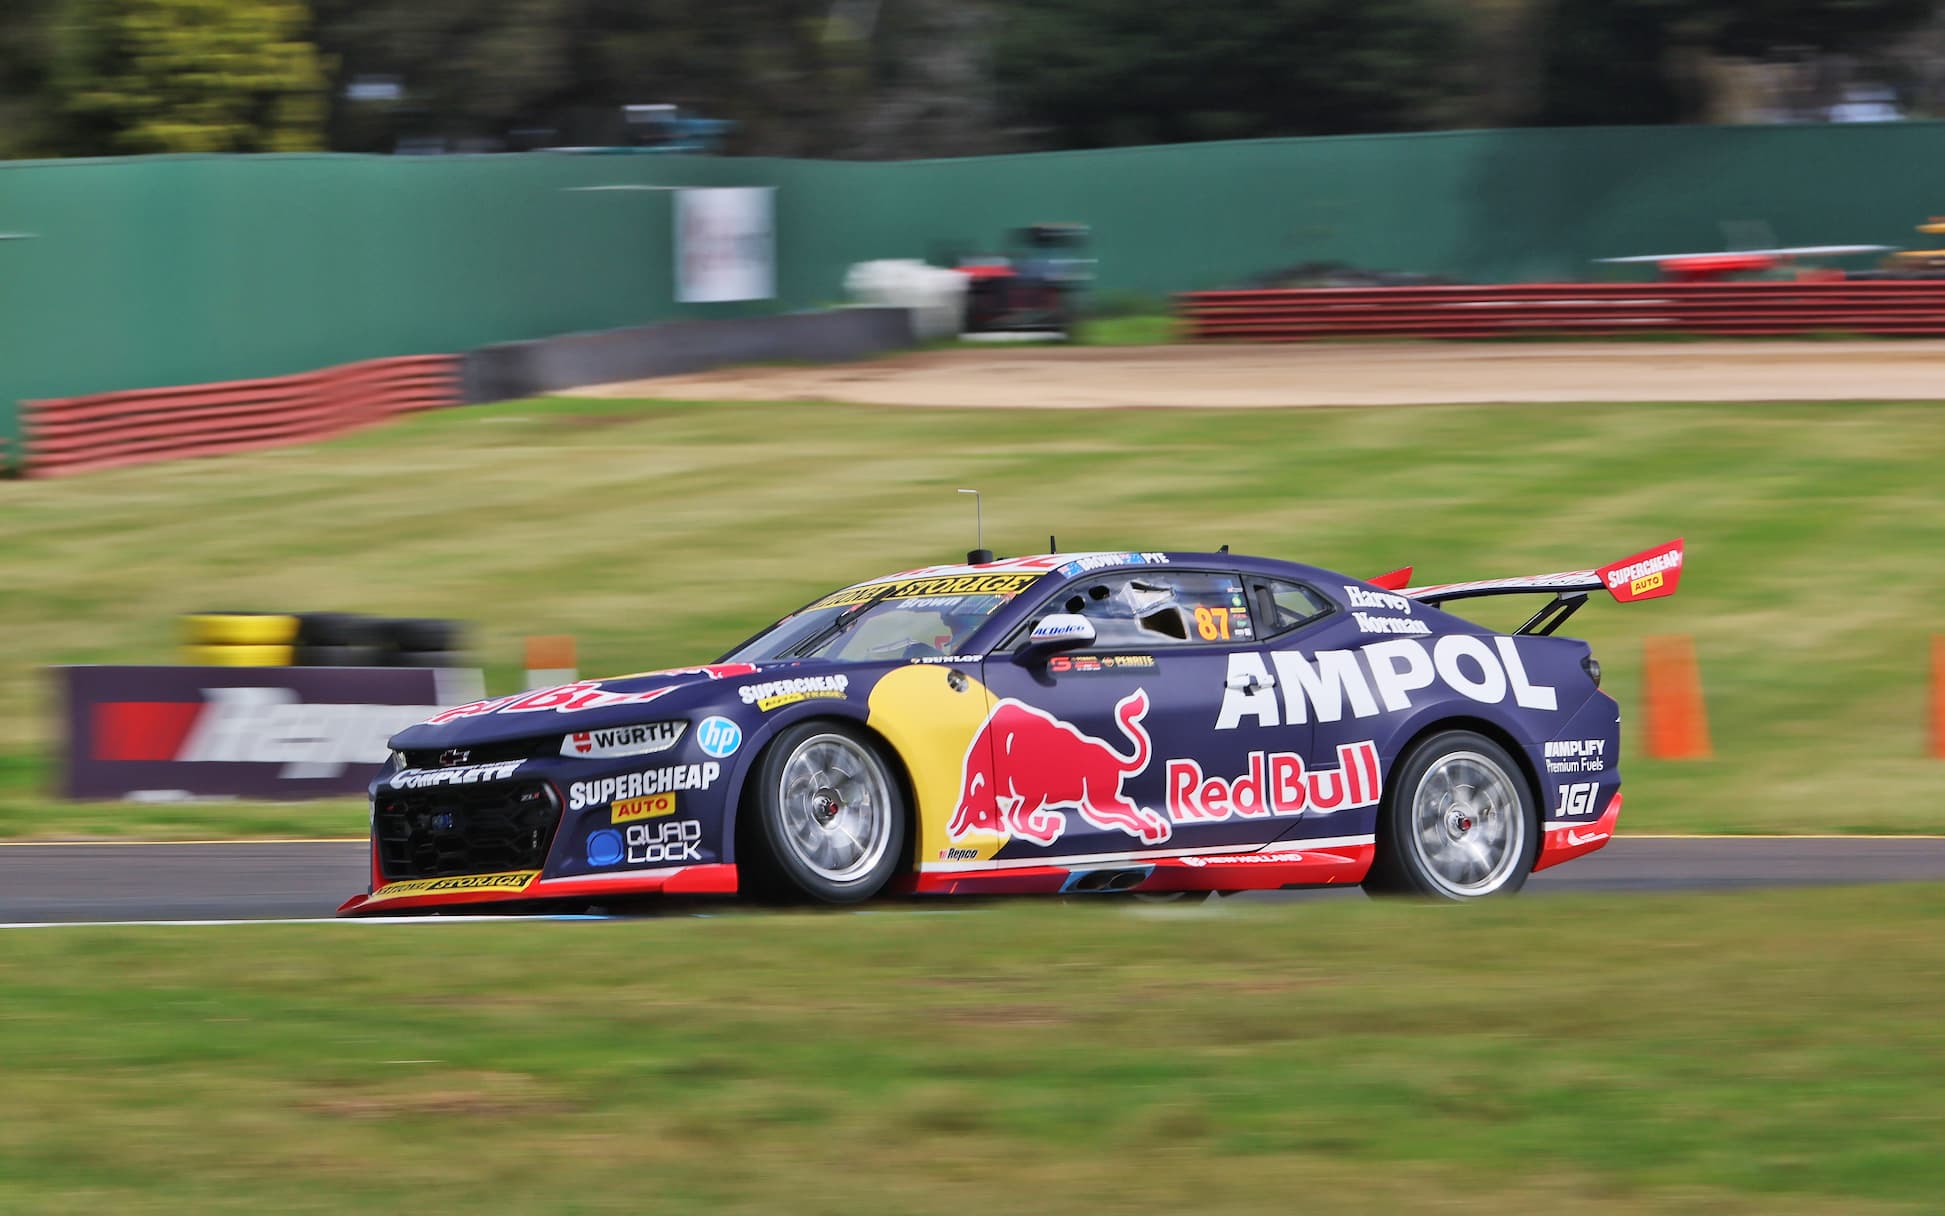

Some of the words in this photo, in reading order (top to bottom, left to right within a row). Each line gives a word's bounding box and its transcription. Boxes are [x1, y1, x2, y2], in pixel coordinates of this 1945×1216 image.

[1607, 550, 1683, 588] SUPERCHEAP
[1634, 576, 1660, 591] AUTO
[1343, 585, 1412, 614] Harvey
[1194, 607, 1230, 640] 87
[1352, 611, 1432, 634] Norman
[738, 674, 849, 704] SUPERCHEAP
[1215, 634, 1558, 730] AMPOL
[594, 722, 675, 748] WÜRTH
[705, 724, 733, 754] hp
[1551, 740, 1605, 757] AMPLIFY
[1546, 758, 1579, 773] Premium
[1581, 757, 1604, 771] Fuels
[569, 761, 721, 810] SUPERCHEAP
[618, 798, 669, 818] AUTO
[1555, 782, 1599, 817] JGI
[626, 820, 702, 847] QUAD
[626, 840, 702, 864] LOCK
[947, 848, 978, 862] Repco
